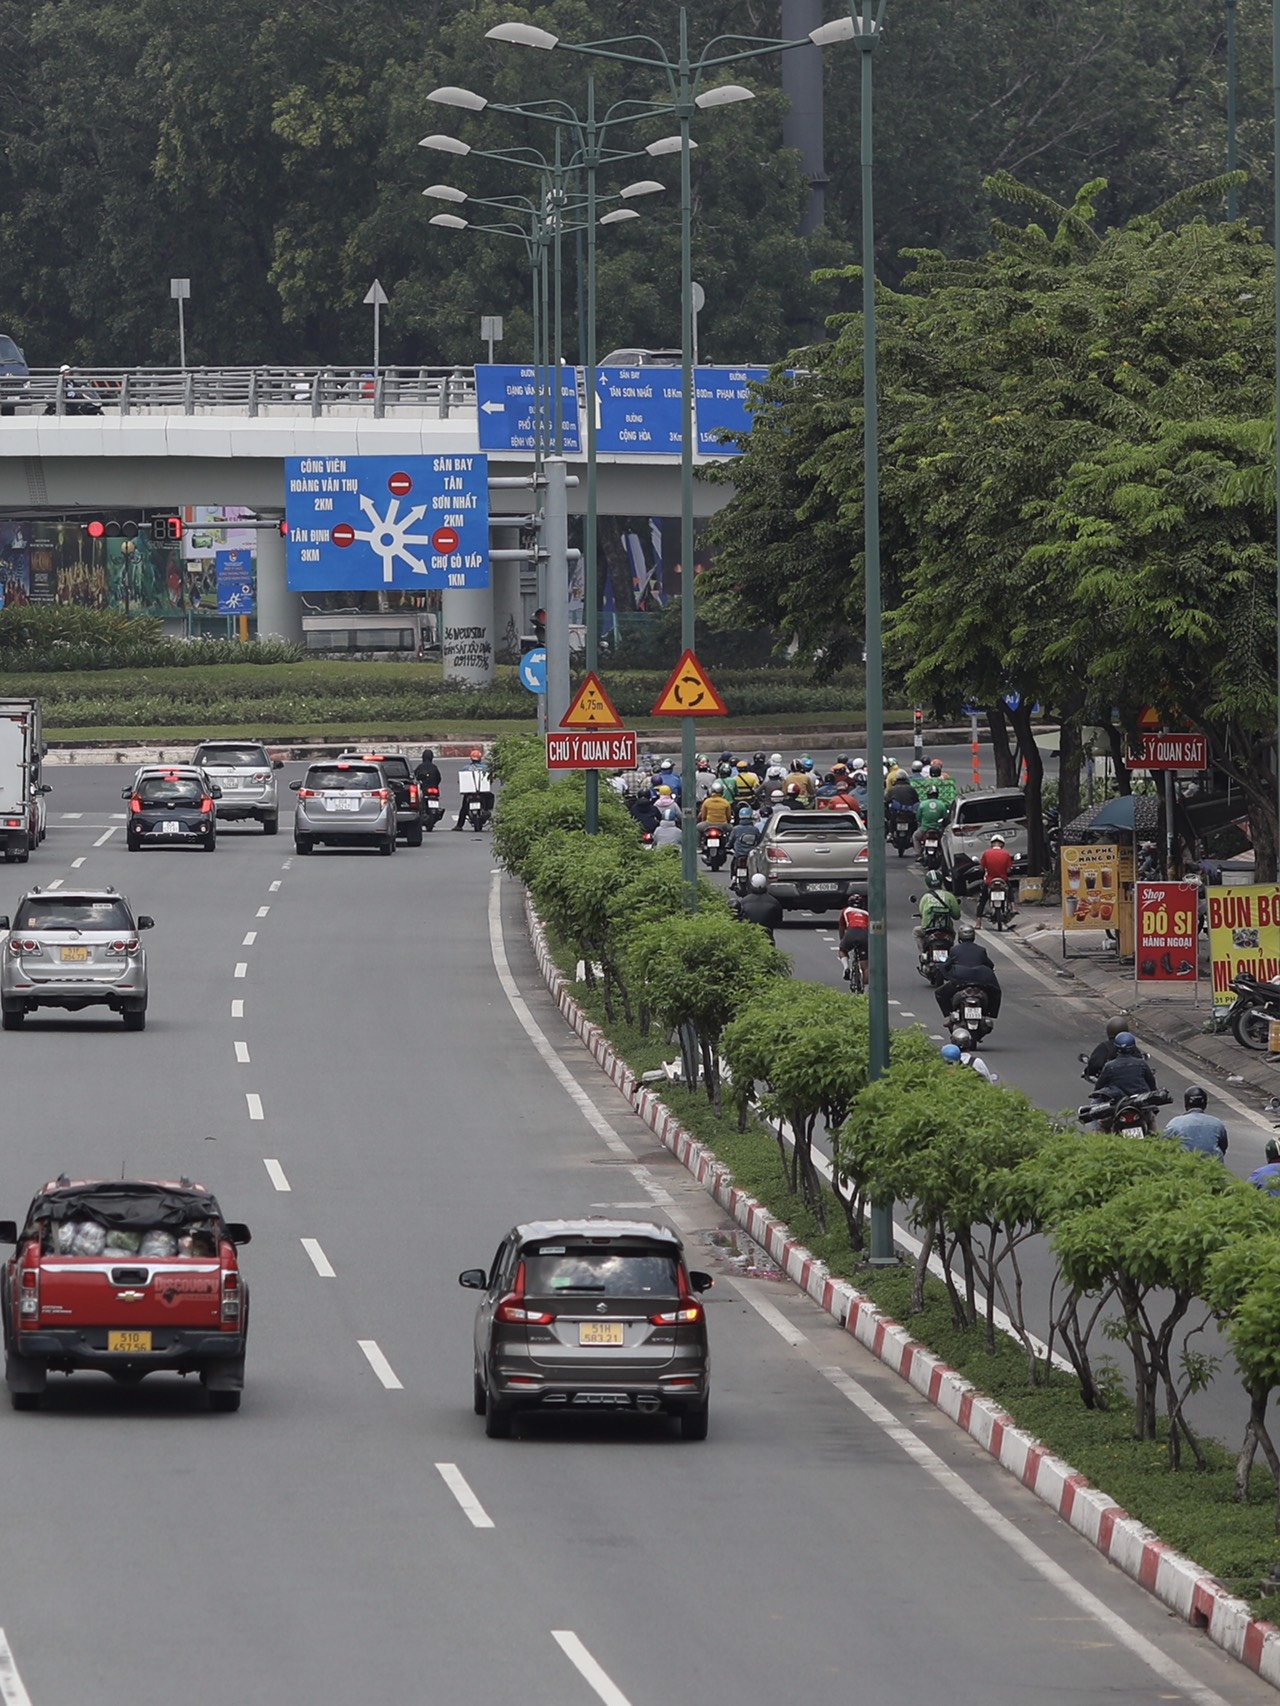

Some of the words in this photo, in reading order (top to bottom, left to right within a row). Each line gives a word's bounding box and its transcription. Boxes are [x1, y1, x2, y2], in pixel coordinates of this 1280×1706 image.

[609, 386, 622, 398] TÂN
[623, 387, 636, 398] SƠN
[636, 385, 653, 398] NHẤT
[716, 388, 735, 400] PHẠM
[619, 428, 637, 442] CỘNG
[638, 428, 652, 441] HÒA
[300, 459, 323, 473] CÔNG
[325, 457, 347, 473] VIÊN
[433, 458, 453, 472] SÂN
[454, 458, 473, 471] BAY
[290, 477, 319, 492] HOÀNG
[321, 477, 340, 492] VĂN
[341, 478, 358, 495] THỤ
[443, 475, 463, 490] TÂN
[314, 498, 333, 511] 2KM
[432, 495, 452, 509] SƠN
[452, 492, 477, 509] NHẤT
[443, 514, 464, 527] 2KM
[290, 528, 309, 543] TÂN
[310, 530, 330, 545] ĐỊNH
[301, 549, 320, 562] 3KM
[431, 554, 449, 571] CHỢ
[450, 553, 464, 568] GÒ
[465, 551, 482, 568] VẤP
[448, 573, 466, 586] 1KM
[580, 700, 603, 711] 4,75m
[549, 736, 569, 761] CHÚ
[572, 736, 580, 761] Ý
[581, 741, 610, 760] QUAN
[612, 736, 632, 760] SÁT
[1148, 739, 1156, 760] Ý
[1157, 742, 1182, 761] QUAN
[1184, 738, 1203, 761] SÁT
[1142, 889, 1165, 902] Shop
[1209, 890, 1252, 930] BÚN
[1143, 904, 1168, 935] ĐỒ
[1174, 911, 1192, 935] SI
[1142, 936, 1165, 947] HÀNG
[1167, 937, 1192, 950] NGOẠI
[1213, 953, 1233, 992] MÌ
[592, 1323, 611, 1333] 51H
[121, 1333, 139, 1342] 51D
